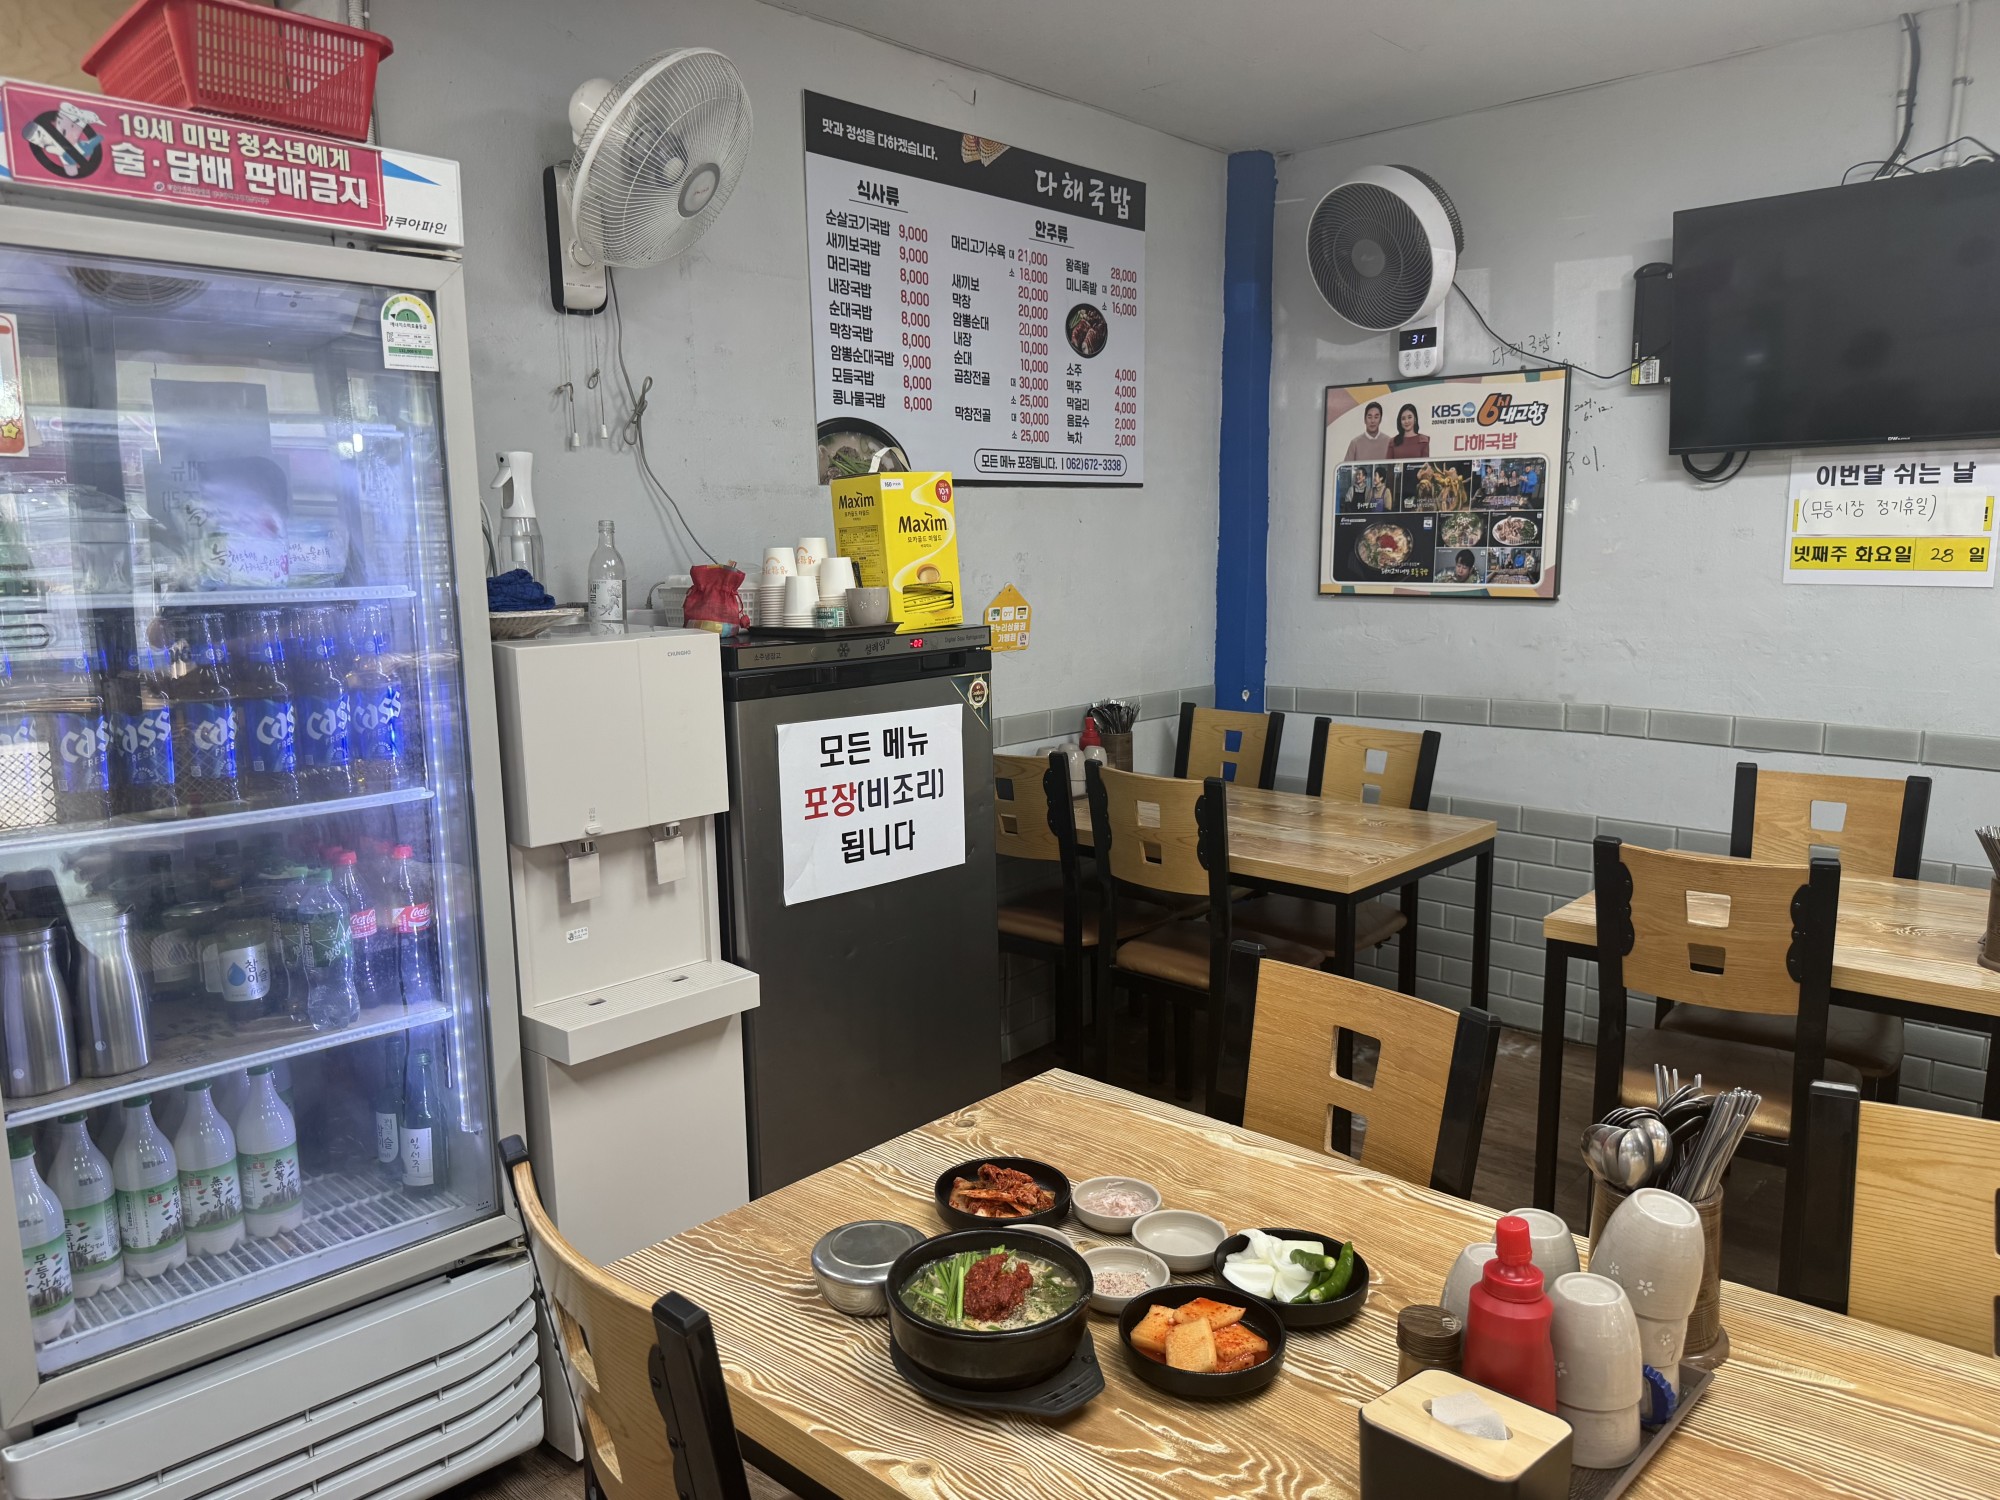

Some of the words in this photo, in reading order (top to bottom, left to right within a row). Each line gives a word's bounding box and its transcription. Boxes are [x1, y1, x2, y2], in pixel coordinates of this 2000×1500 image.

[119, 113, 174, 144] 19세
[181, 123, 231, 153] 미만
[237, 132, 350, 172] 청소년에게
[822, 118, 844, 137] 맛과
[846, 124, 876, 145] 정성을
[877, 132, 939, 160] 다하겠습니다.
[244, 161, 369, 209] 판매금지
[857, 180, 900, 206] 식사류
[1034, 169, 1131, 220] 다해국밥
[825, 209, 890, 236] 순살코기국밥
[899, 224, 928, 243] 9,000
[1035, 220, 1068, 243] 안주류
[826, 232, 881, 256] 새끼보국밥
[899, 246, 928, 264] 9,000
[951, 234, 1006, 260] 머리고기수육
[1008, 249, 1015, 260] 대
[1018, 248, 1048, 267] 21,000
[827, 254, 871, 277] 머리국밥
[900, 268, 929, 286] 8,000
[1009, 268, 1015, 278] 소
[1019, 267, 1048, 285] 18,000
[1065, 258, 1090, 276] 왕족발
[1110, 267, 1137, 283] 28,000
[828, 277, 872, 299] 내장국밥
[900, 289, 930, 307] 8,000
[951, 273, 980, 292] 새끼보
[1018, 285, 1048, 303] 20,000
[1066, 277, 1097, 296] 미니족발
[1110, 284, 1137, 300] 20,000
[829, 300, 872, 321] 순대국밥
[901, 311, 930, 328] 8,000
[952, 292, 971, 310] 막창
[1018, 304, 1048, 321] 20,000
[1111, 301, 1137, 317] 16,000
[830, 322, 873, 343] 막창국밥
[902, 332, 931, 349] 8,000
[952, 311, 990, 331] 암뽕순대
[1019, 322, 1048, 339] 20,000
[953, 331, 972, 347] 내장
[1020, 340, 1048, 356] 10,000
[1411, 334, 1425, 345] 31
[830, 345, 895, 367] 암뽕순대국밥
[903, 354, 932, 370] 9,000
[954, 350, 973, 366] 순대
[1020, 358, 1049, 374] 10,000
[831, 367, 874, 386] 모듬국밥
[903, 375, 932, 391] 8,000
[954, 369, 991, 386] 곱창전골
[1010, 378, 1017, 388] 대
[1019, 376, 1049, 392] 30,000
[1066, 363, 1083, 377] 소주
[1114, 368, 1137, 382] 4,000
[832, 389, 885, 408] 콩나물국밥
[904, 396, 932, 412] 8,000
[1066, 379, 1083, 394] 맥주
[1114, 385, 1137, 399] 4,000
[1010, 395, 1017, 405] 소
[1020, 394, 1049, 409] 25,000
[1066, 397, 1090, 412] 막걸리
[1114, 402, 1137, 415] 4,000
[1432, 404, 1461, 418] KBS
[954, 406, 991, 423] 막창전골
[1011, 413, 1017, 422] 대
[1020, 412, 1049, 426] 30,000
[1066, 414, 1090, 428] 음료수
[1114, 418, 1137, 431] 2,000
[1500, 402, 1546, 426] 내고향
[1011, 430, 1018, 440] 소
[1020, 429, 1050, 444] 25,000
[1066, 431, 1083, 445] 녹차
[1114, 434, 1137, 447] 2,000
[1453, 432, 1518, 451] 다해국밥
[981, 454, 998, 468] 모든
[1000, 455, 1016, 469] 메뉴
[1017, 456, 1058, 470] 포장됩니다.
[1066, 457, 1122, 472] 062)672-3338
[1815, 463, 1886, 486] 이번달
[1893, 462, 1941, 485] 쉬는
[1953, 461, 1977, 484] 날
[838, 492, 875, 510] Maxim
[1876, 494, 1938, 522] 정기휴일)
[898, 512, 948, 534] Maxim
[1794, 545, 1848, 563] 넷째주
[1854, 545, 1913, 563] 화요일
[1929, 547, 1955, 563] 28
[1968, 546, 1986, 563] 일
[819, 731, 871, 768] 모든
[882, 726, 929, 760] 메뉴
[804, 768, 944, 821] 포장(비조리)
[841, 819, 916, 864] 됩니다
